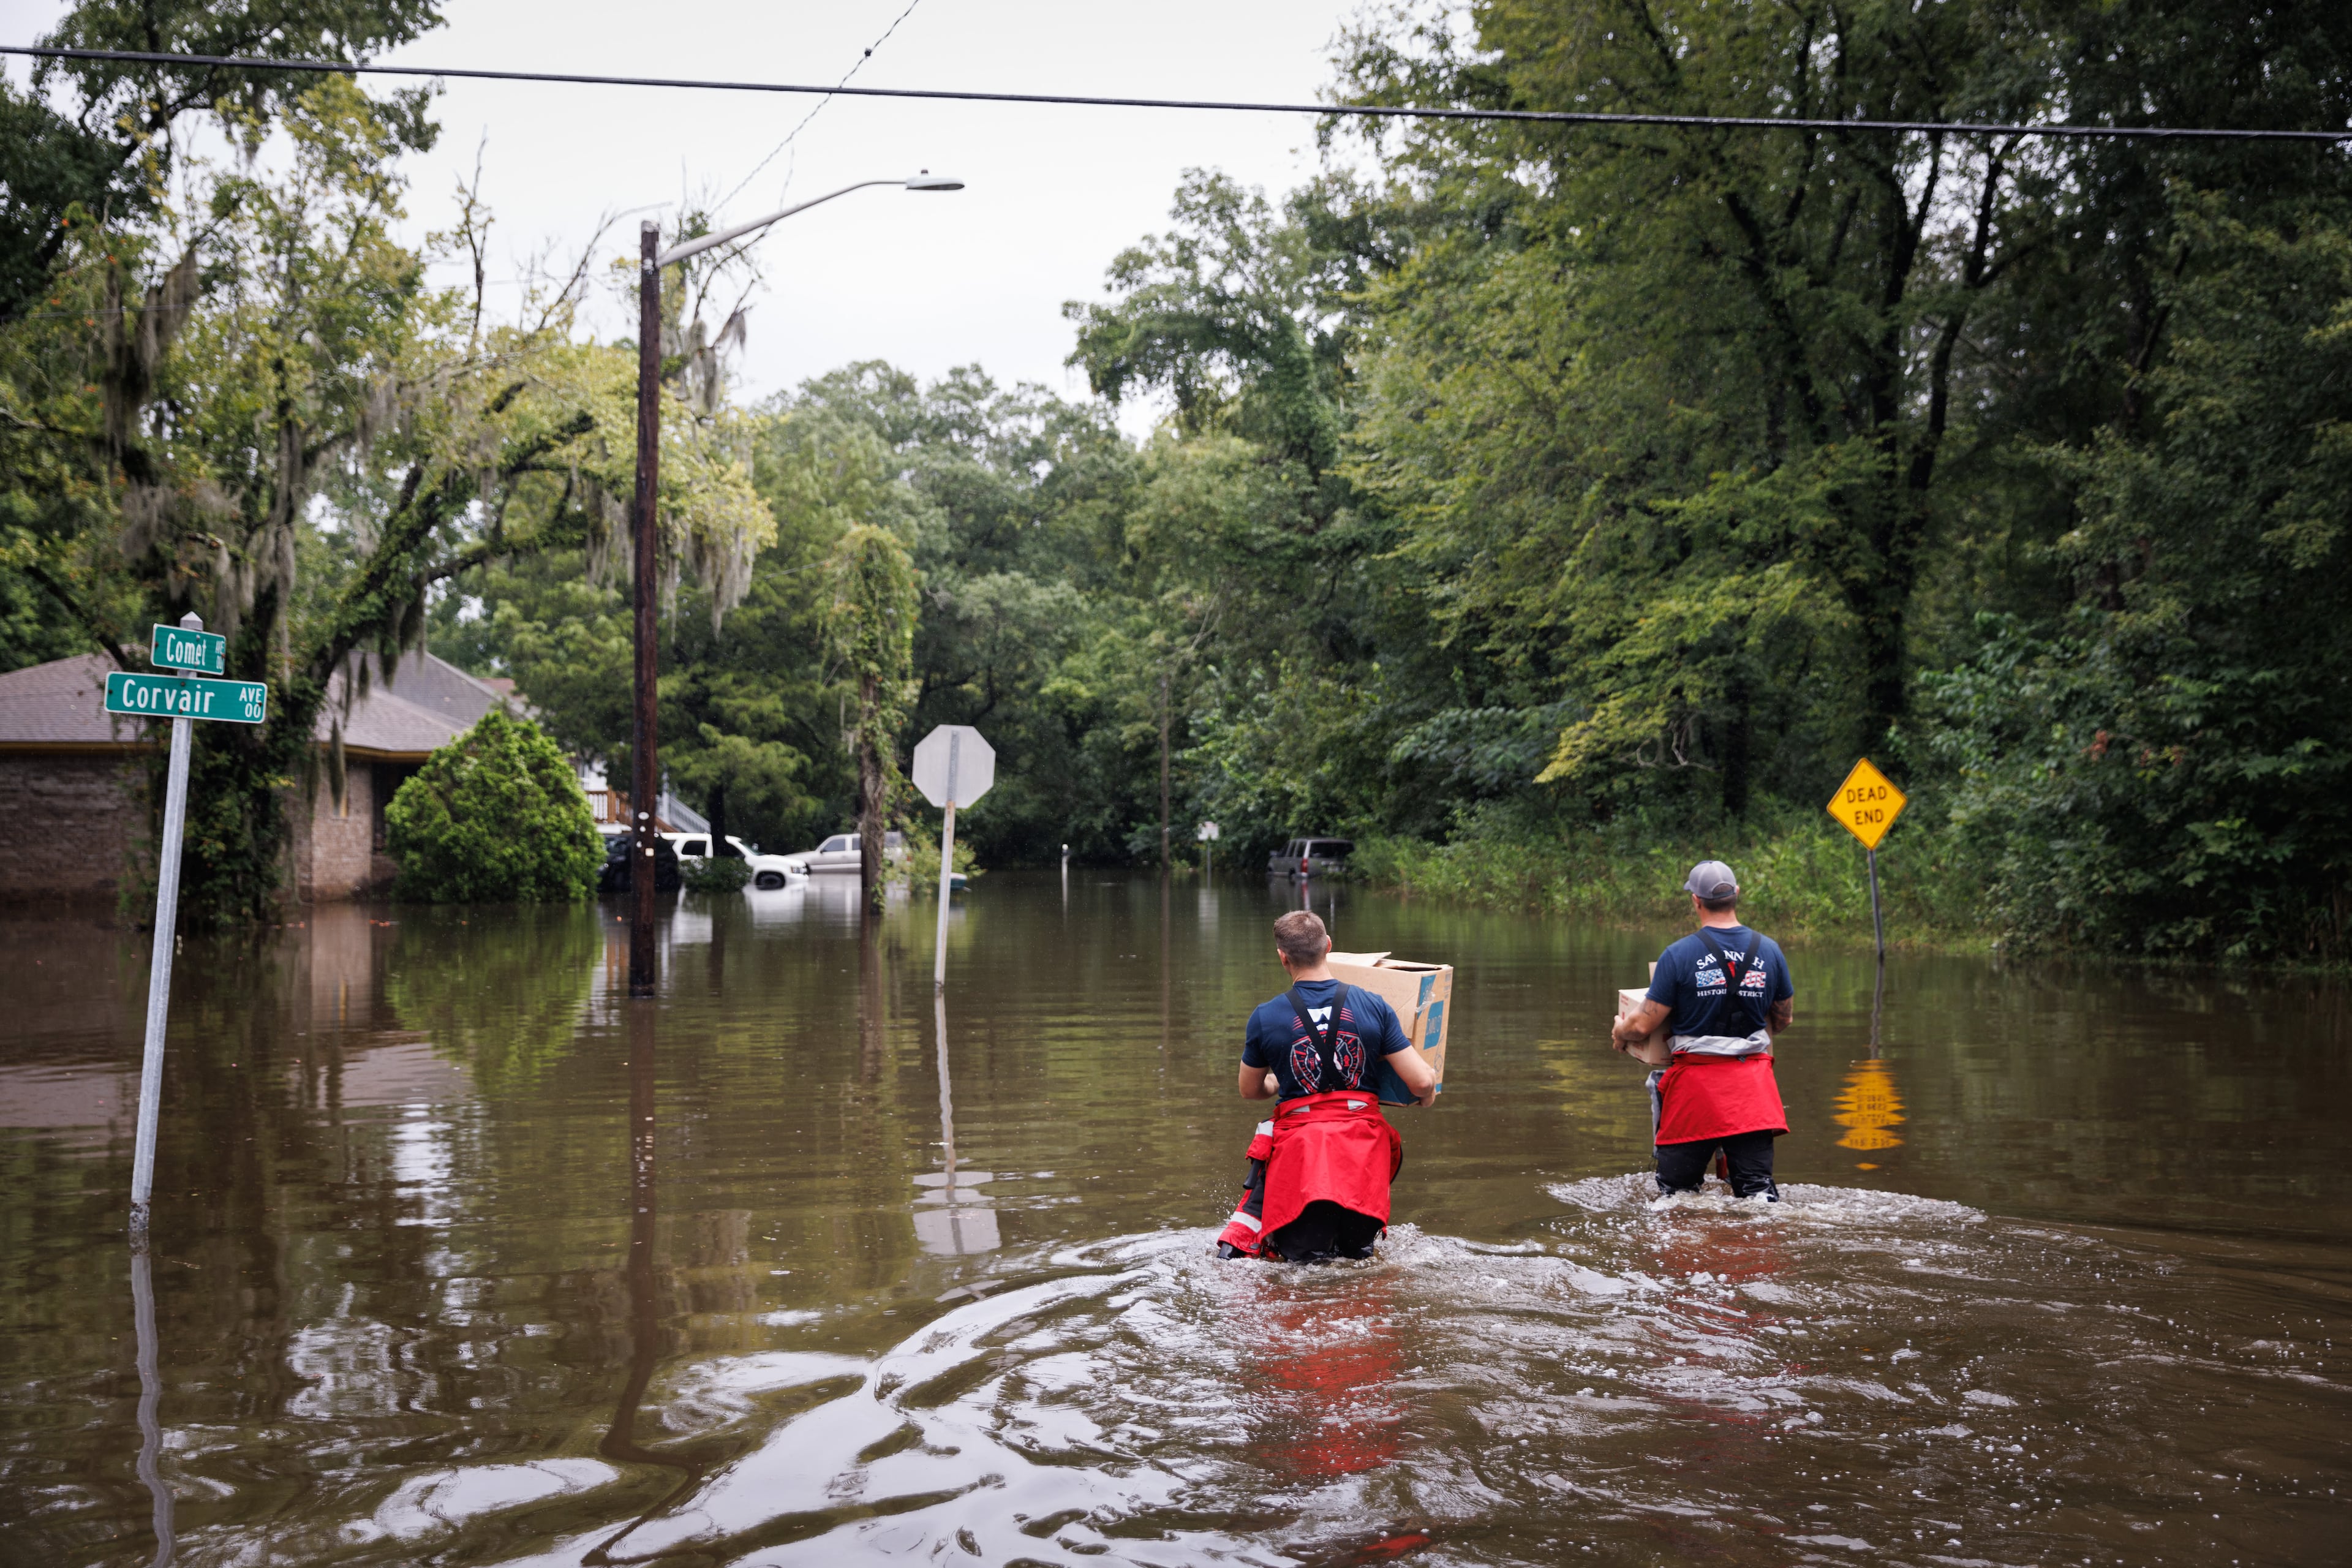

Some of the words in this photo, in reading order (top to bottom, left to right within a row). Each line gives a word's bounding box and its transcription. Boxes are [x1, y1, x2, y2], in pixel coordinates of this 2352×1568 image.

[166, 633, 207, 666] Comet
[123, 679, 215, 714] Corvair
[239, 687, 263, 703] AVE
[244, 703, 262, 718] 00
[1846, 786, 1887, 803] DEAD
[1855, 809, 1884, 826] END
